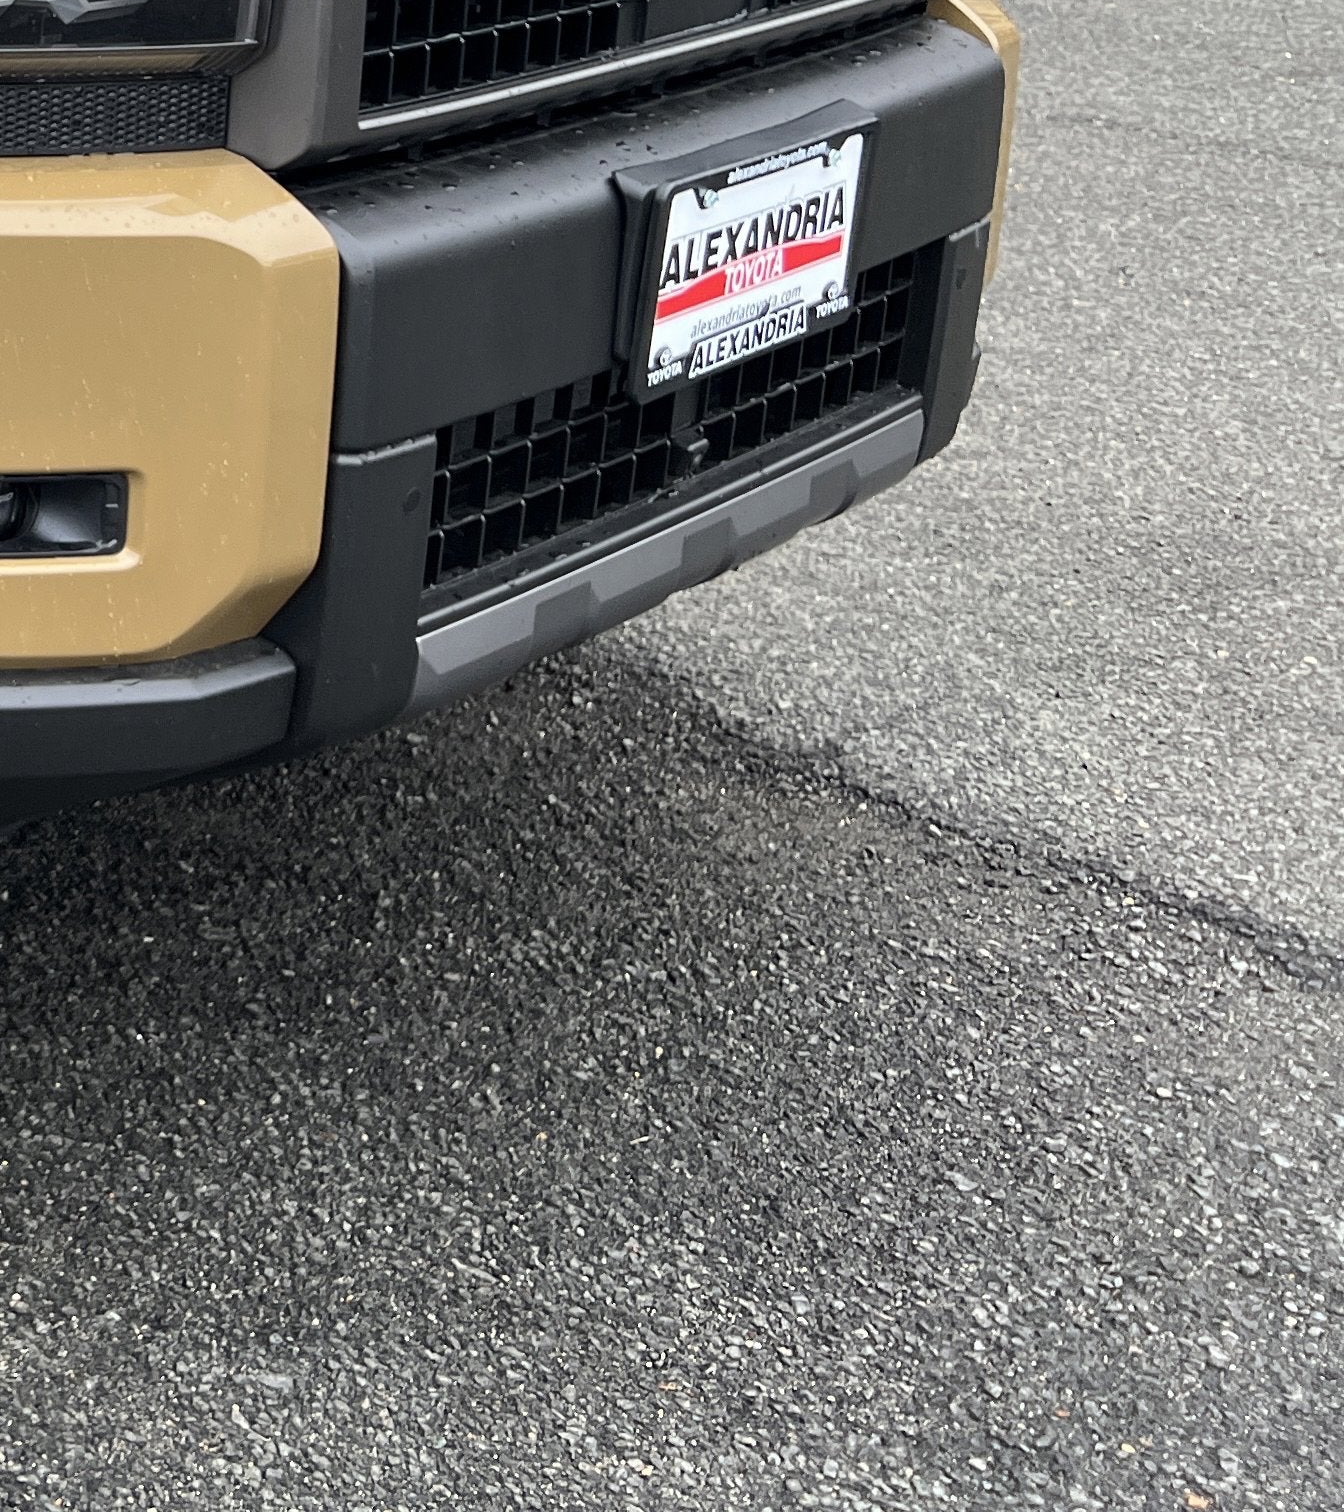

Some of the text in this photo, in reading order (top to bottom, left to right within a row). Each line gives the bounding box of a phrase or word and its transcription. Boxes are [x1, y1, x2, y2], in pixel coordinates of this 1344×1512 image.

[661, 185, 846, 287] ALEXANDRIA
[725, 249, 784, 290] TOYOTA
[815, 295, 849, 319] TOYOTA
[691, 306, 805, 374] ALEXANDRIA
[647, 361, 683, 388] TOYOTA
